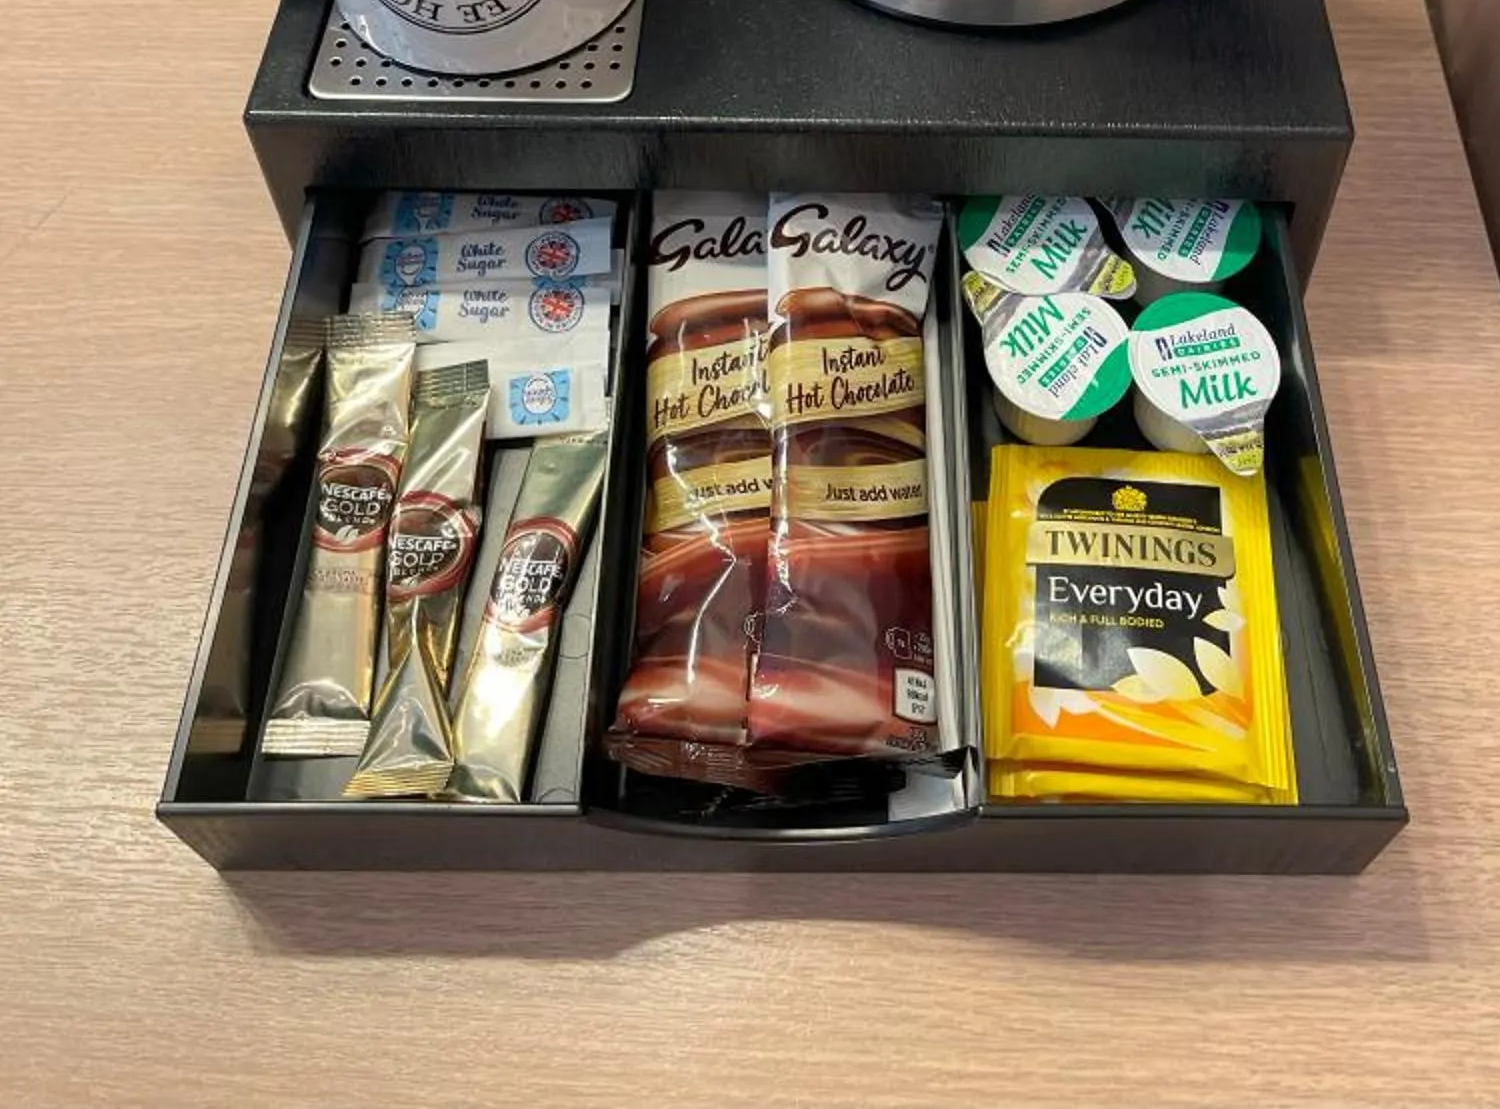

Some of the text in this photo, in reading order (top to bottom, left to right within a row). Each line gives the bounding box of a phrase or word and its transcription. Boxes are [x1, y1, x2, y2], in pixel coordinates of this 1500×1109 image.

[471, 206, 521, 227] Sugar
[460, 241, 507, 258] White
[768, 202, 927, 293] Galaxy
[1031, 219, 1088, 280] Milk
[456, 256, 507, 277] Sugar
[463, 289, 509, 304] White
[457, 301, 510, 324] Sugar
[1000, 295, 1065, 358] Milk
[1170, 322, 1237, 346] Lakeland
[822, 344, 886, 375] Instant
[1151, 350, 1261, 378] SEMI-SKIMMED
[786, 368, 914, 414] Hot Chocolate
[1180, 371, 1258, 409] Milk
[654, 391, 690, 428] Hot
[725, 477, 760, 494] add
[825, 483, 857, 501] Just
[859, 484, 888, 502] add
[324, 497, 381, 516] GOLD
[1045, 529, 1217, 568] TWININGS
[1047, 575, 1203, 621] Everyday
[1090, 614, 1118, 627] FULL
[1120, 615, 1166, 628] BODIED
